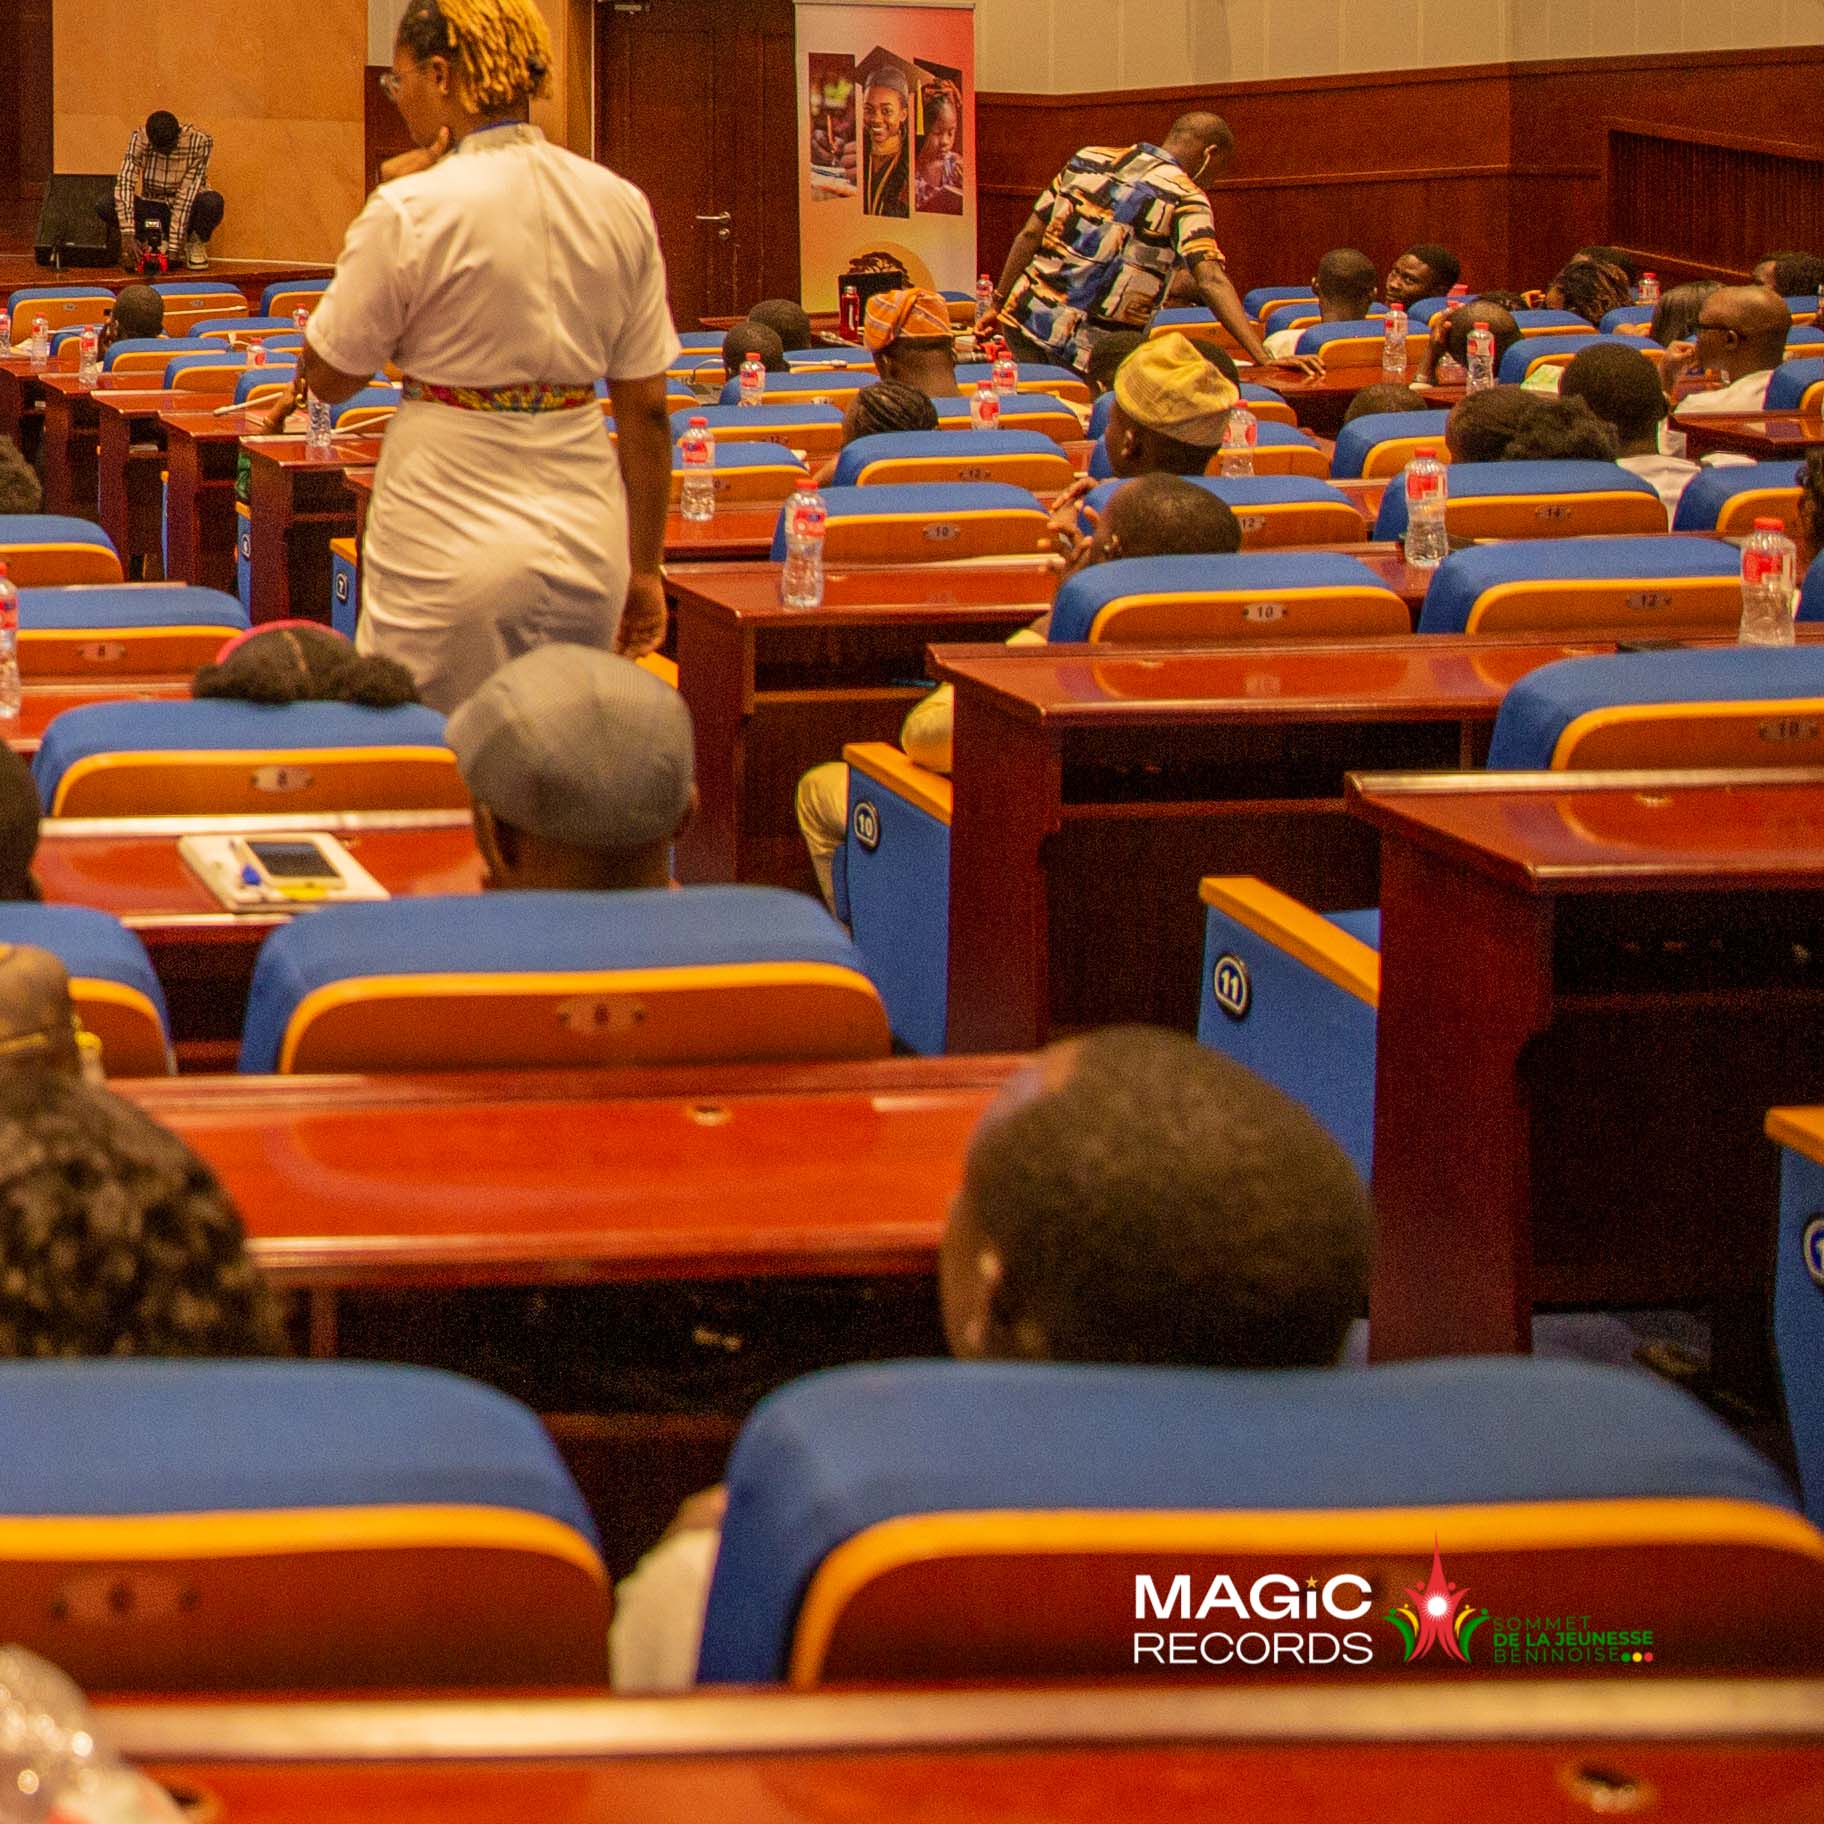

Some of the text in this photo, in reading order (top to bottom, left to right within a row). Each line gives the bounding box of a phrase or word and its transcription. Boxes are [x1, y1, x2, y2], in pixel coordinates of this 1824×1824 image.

[935, 526, 950, 537] 10
[1257, 606, 1275, 618] 10
[858, 810, 874, 837] 10
[1220, 969, 1240, 1003] 11
